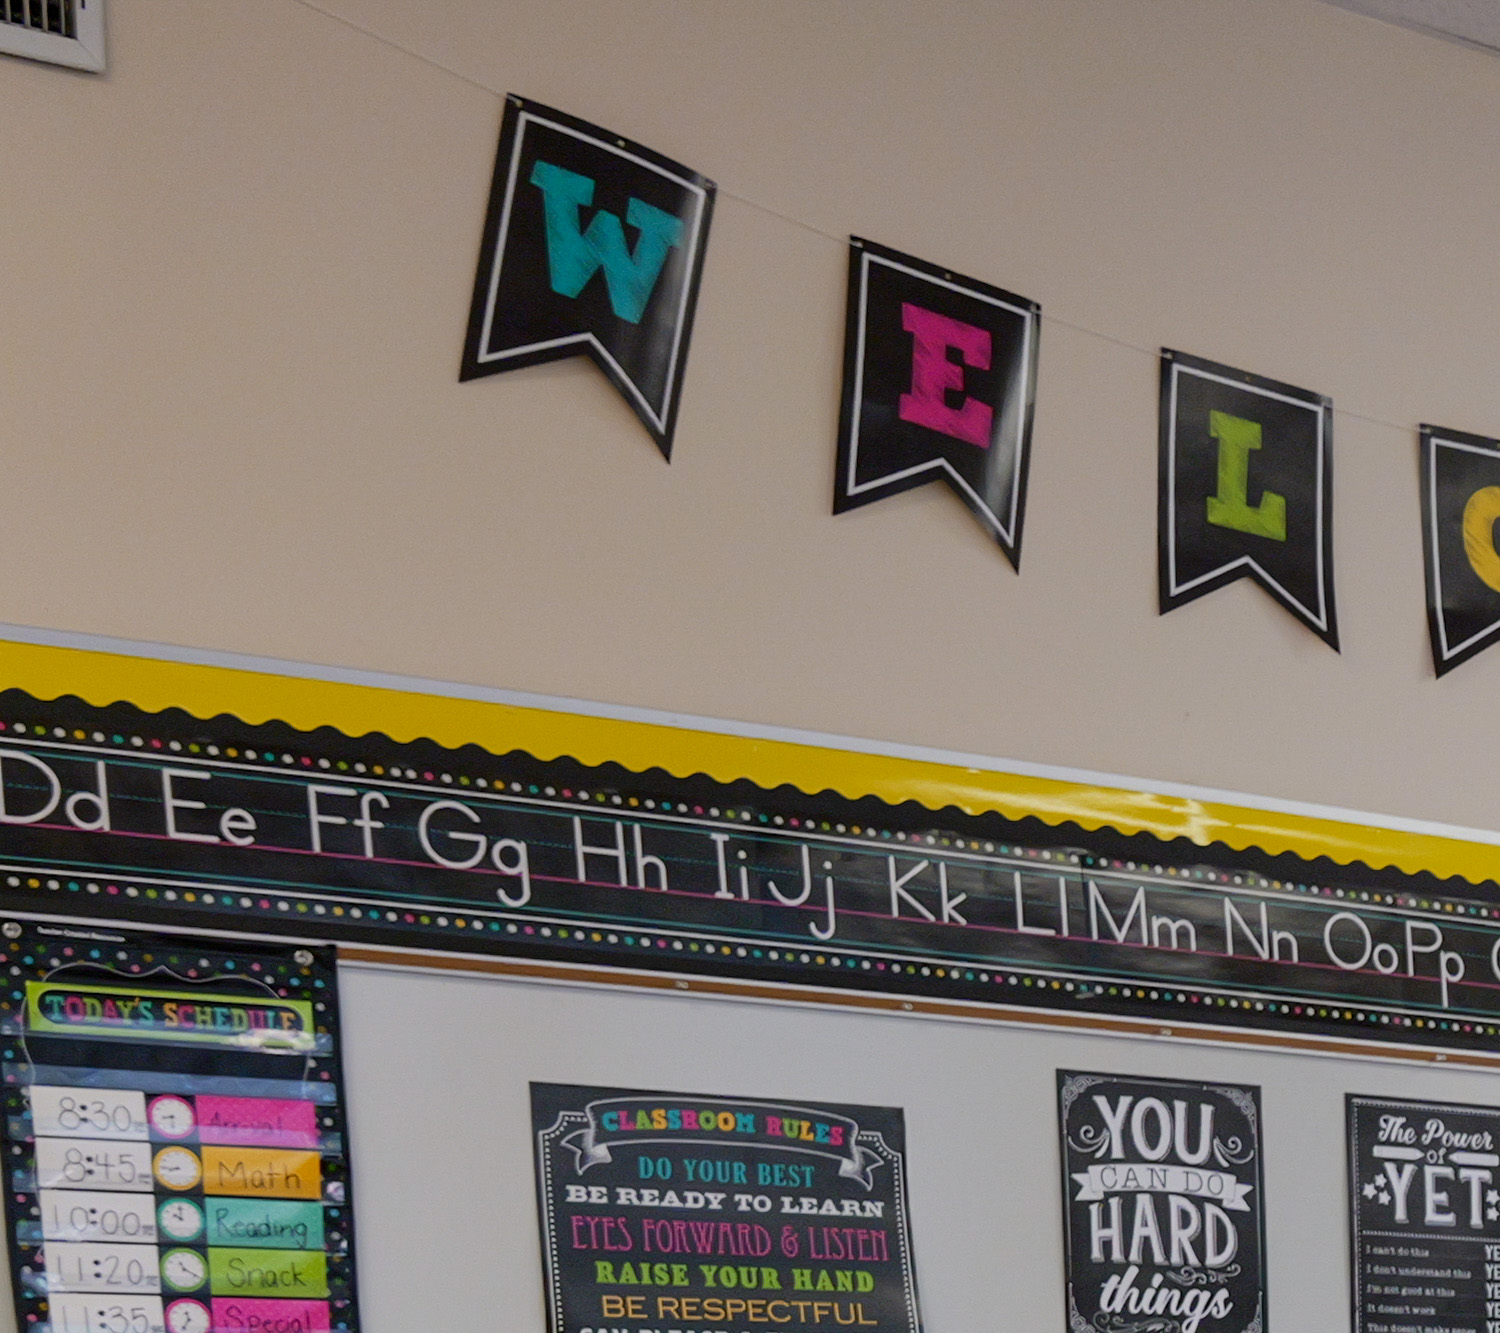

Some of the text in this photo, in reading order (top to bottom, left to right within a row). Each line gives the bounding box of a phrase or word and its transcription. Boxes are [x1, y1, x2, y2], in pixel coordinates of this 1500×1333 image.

[45, 994, 297, 1031] TODAY'S SCHEDULE
[58, 1097, 131, 1131] 8:30
[602, 1109, 845, 1147] CLASSROOM RULES
[1092, 1096, 1216, 1165] YOU
[1378, 1114, 1494, 1150] The Power
[62, 1149, 136, 1183] 8:45
[637, 1156, 815, 1188] DO YOUR BEST
[1426, 1148, 1447, 1164] of
[218, 1161, 301, 1189] Math
[1101, 1167, 1224, 1196] CAN DO
[565, 1184, 885, 1218] BE READY TO LEARN
[1384, 1162, 1493, 1229] YET
[53, 1207, 141, 1236] 10:00
[216, 1208, 308, 1238] Reading
[1089, 1193, 1238, 1268] HARD
[571, 1216, 890, 1261] EYES FORWARD & LISTEN
[57, 1256, 143, 1286] 11:20
[227, 1258, 306, 1288] Snack
[595, 1260, 875, 1292] RAISE YOUR HAND
[601, 1295, 878, 1326] BE RESPECTFUL
